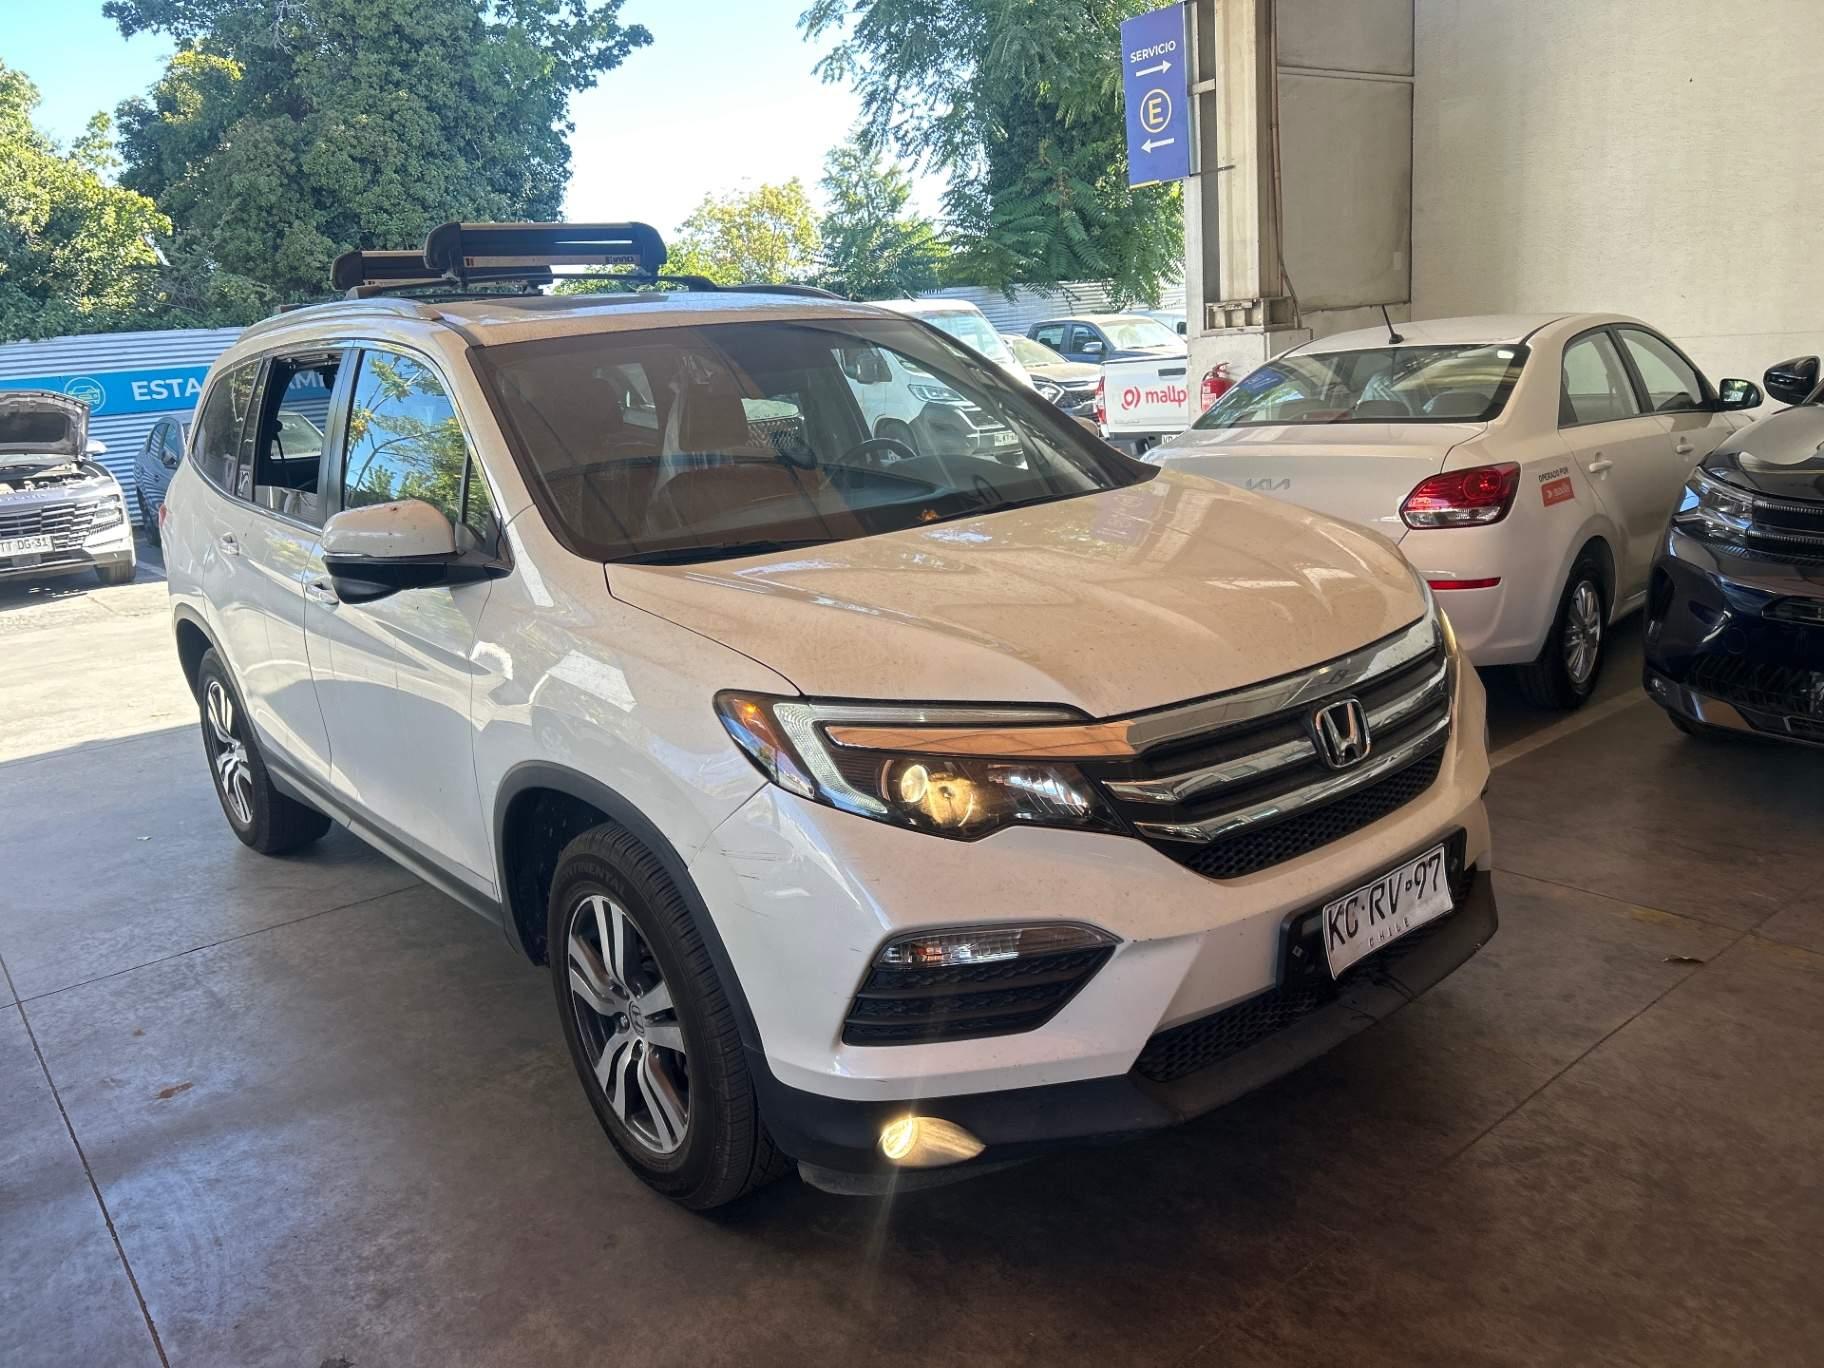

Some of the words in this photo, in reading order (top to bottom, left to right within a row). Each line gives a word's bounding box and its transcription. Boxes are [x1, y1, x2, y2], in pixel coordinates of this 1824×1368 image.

[1129, 40, 1176, 64] SERVICIO
[1148, 97, 1163, 125] E
[1369, 917, 1409, 948] CHILE
